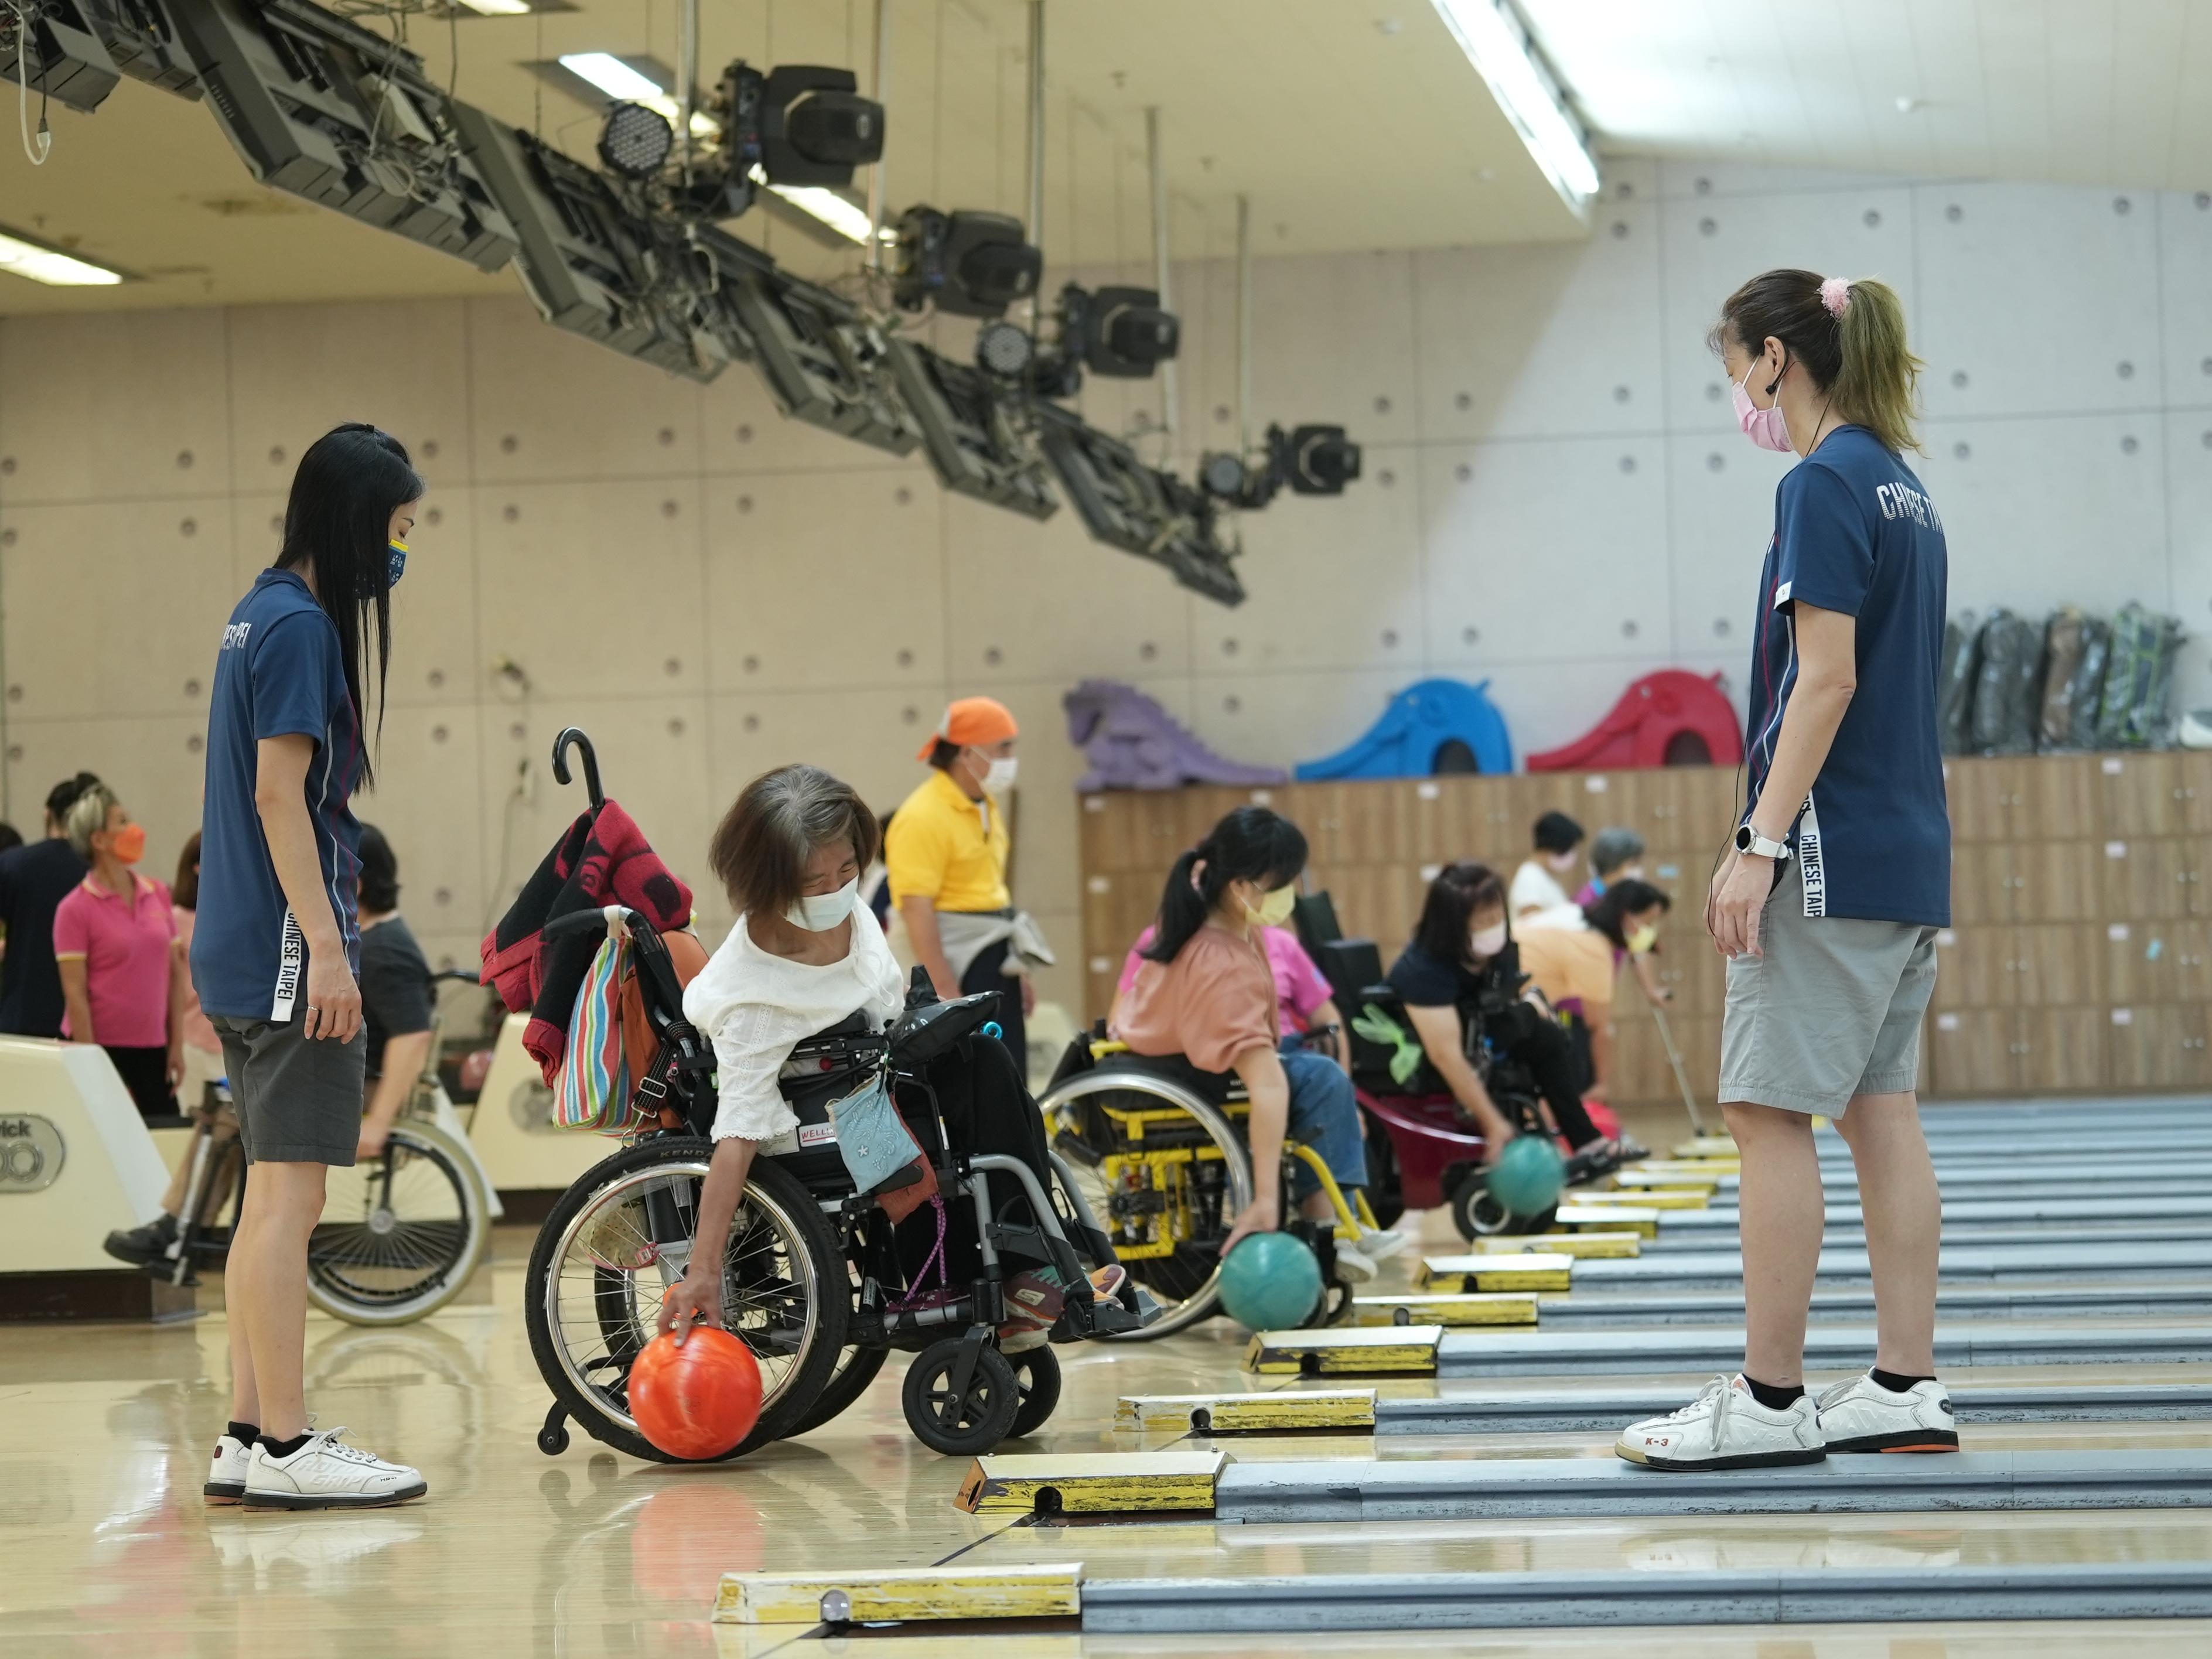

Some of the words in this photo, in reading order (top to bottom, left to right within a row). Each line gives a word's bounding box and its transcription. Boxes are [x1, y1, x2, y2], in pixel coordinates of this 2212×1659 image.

[1801, 835, 1821, 886] CHINESE
[277, 964, 298, 1000] TAIPEI
[0, 1120, 31, 1137] ick
[1645, 1438, 1669, 1446] K-3
[1769, 1433, 1791, 1446] PRO
[297, 1460, 360, 1473] ROTO
[309, 1474, 365, 1489] GRIP
